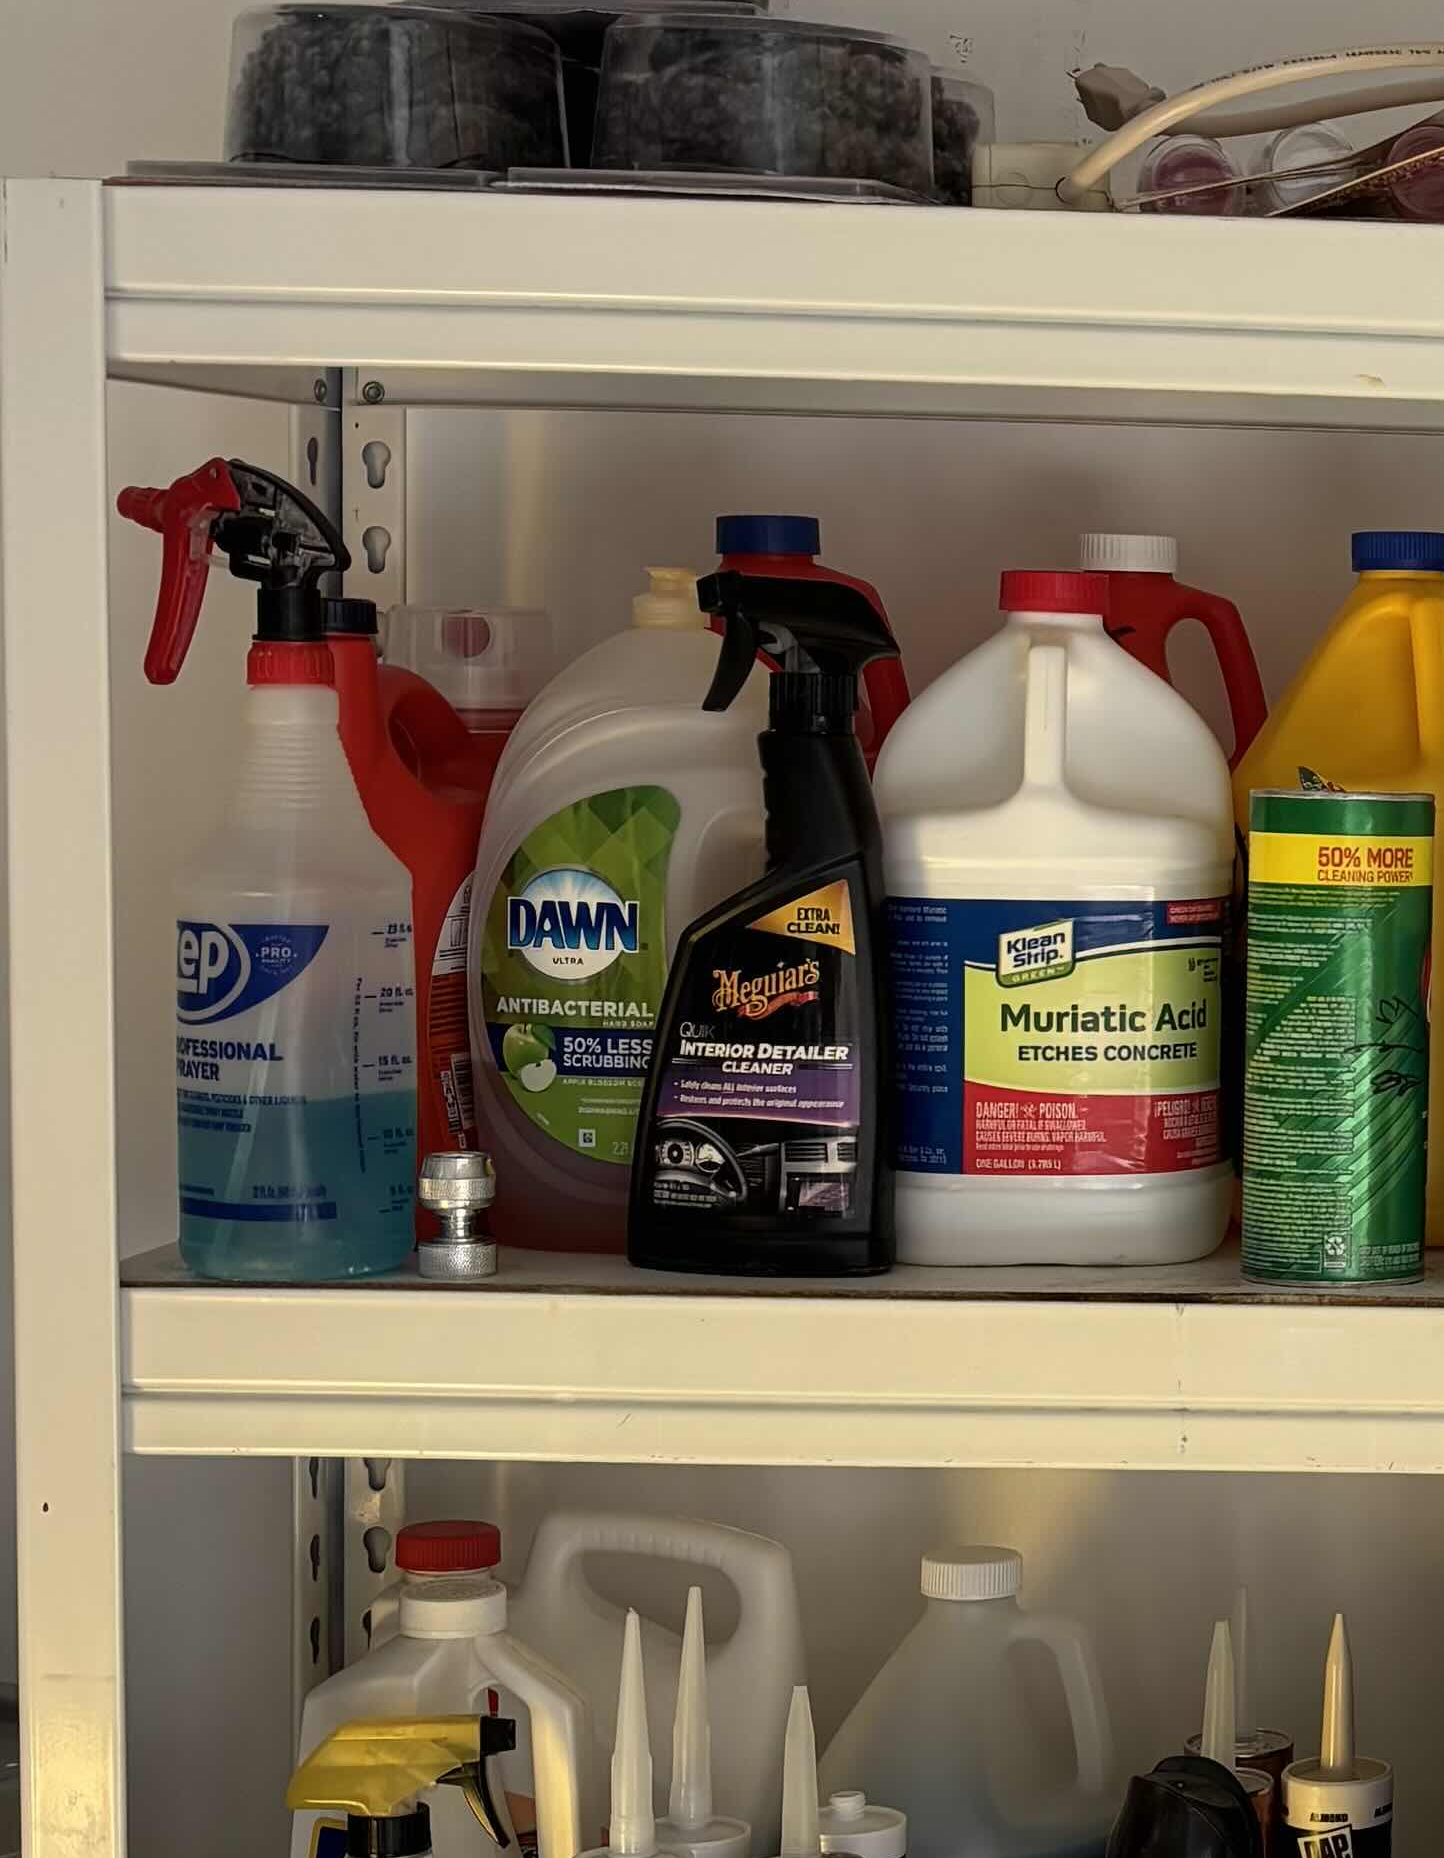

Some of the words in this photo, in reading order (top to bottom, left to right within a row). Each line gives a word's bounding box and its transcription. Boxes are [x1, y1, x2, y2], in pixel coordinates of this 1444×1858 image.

[1317, 846, 1362, 869] 50%
[1366, 847, 1414, 869] MORE
[1316, 869, 1374, 883] CLEANING
[508, 895, 640, 954] DAWN
[797, 907, 831, 922] EXTRA
[786, 921, 841, 935] CLEAN!
[260, 946, 292, 959] PRO
[1006, 930, 1066, 955] Klean
[552, 956, 584, 966] ULTRA
[712, 957, 820, 1014] Meguiar's
[496, 996, 655, 1019] ANTIBACTERIAL
[1000, 1003, 1146, 1034] Muriatic
[1155, 998, 1208, 1032] Acid
[177, 1036, 284, 1062] OFESSIONAL
[563, 1037, 601, 1054] 50%
[607, 1038, 653, 1056] LESS
[679, 1039, 754, 1060] INTERIOR
[757, 1042, 849, 1061] DETAILER
[1017, 1045, 1098, 1062] ETCHES
[1103, 1042, 1198, 1061] CONCRETE
[722, 1060, 793, 1076] CLEANER
[975, 1102, 1019, 1119] DANGER!
